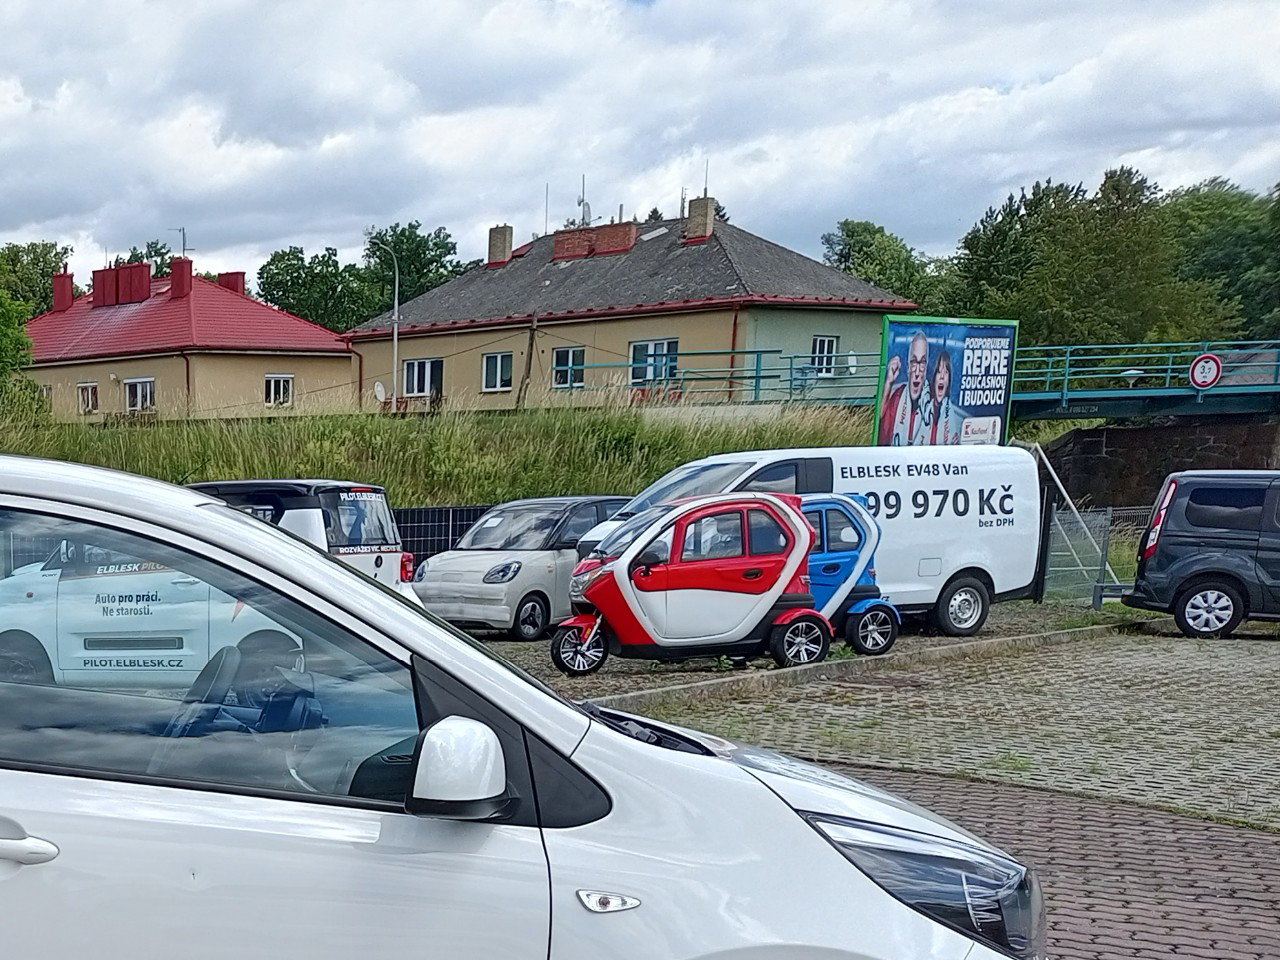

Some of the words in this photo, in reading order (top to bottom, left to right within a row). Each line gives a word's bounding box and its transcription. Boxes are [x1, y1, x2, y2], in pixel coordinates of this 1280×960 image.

[964, 337, 1010, 349] PODPORUJEME
[962, 349, 1010, 375] REPRE
[960, 374, 1007, 389] SOUČASNOU
[958, 390, 963, 406] I
[963, 389, 1005, 406] BUDOUCÍ
[840, 465, 901, 479] ELBLESK
[907, 464, 940, 477] EV48
[942, 463, 969, 476] Van
[844, 490, 902, 519] 99
[911, 488, 970, 519] 970
[978, 484, 1014, 516] Kč
[978, 518, 994, 528] bez
[996, 518, 1014, 527] DPH
[96, 563, 141, 574] ELBLESK
[141, 562, 170, 571] PILO
[94, 593, 116, 604] Auto
[118, 594, 133, 605] pro
[135, 591, 161, 605] práci.
[102, 606, 115, 617] Ne
[116, 605, 153, 616] starosti.
[83, 659, 184, 668] PILOT.ELBLESK.CZ
